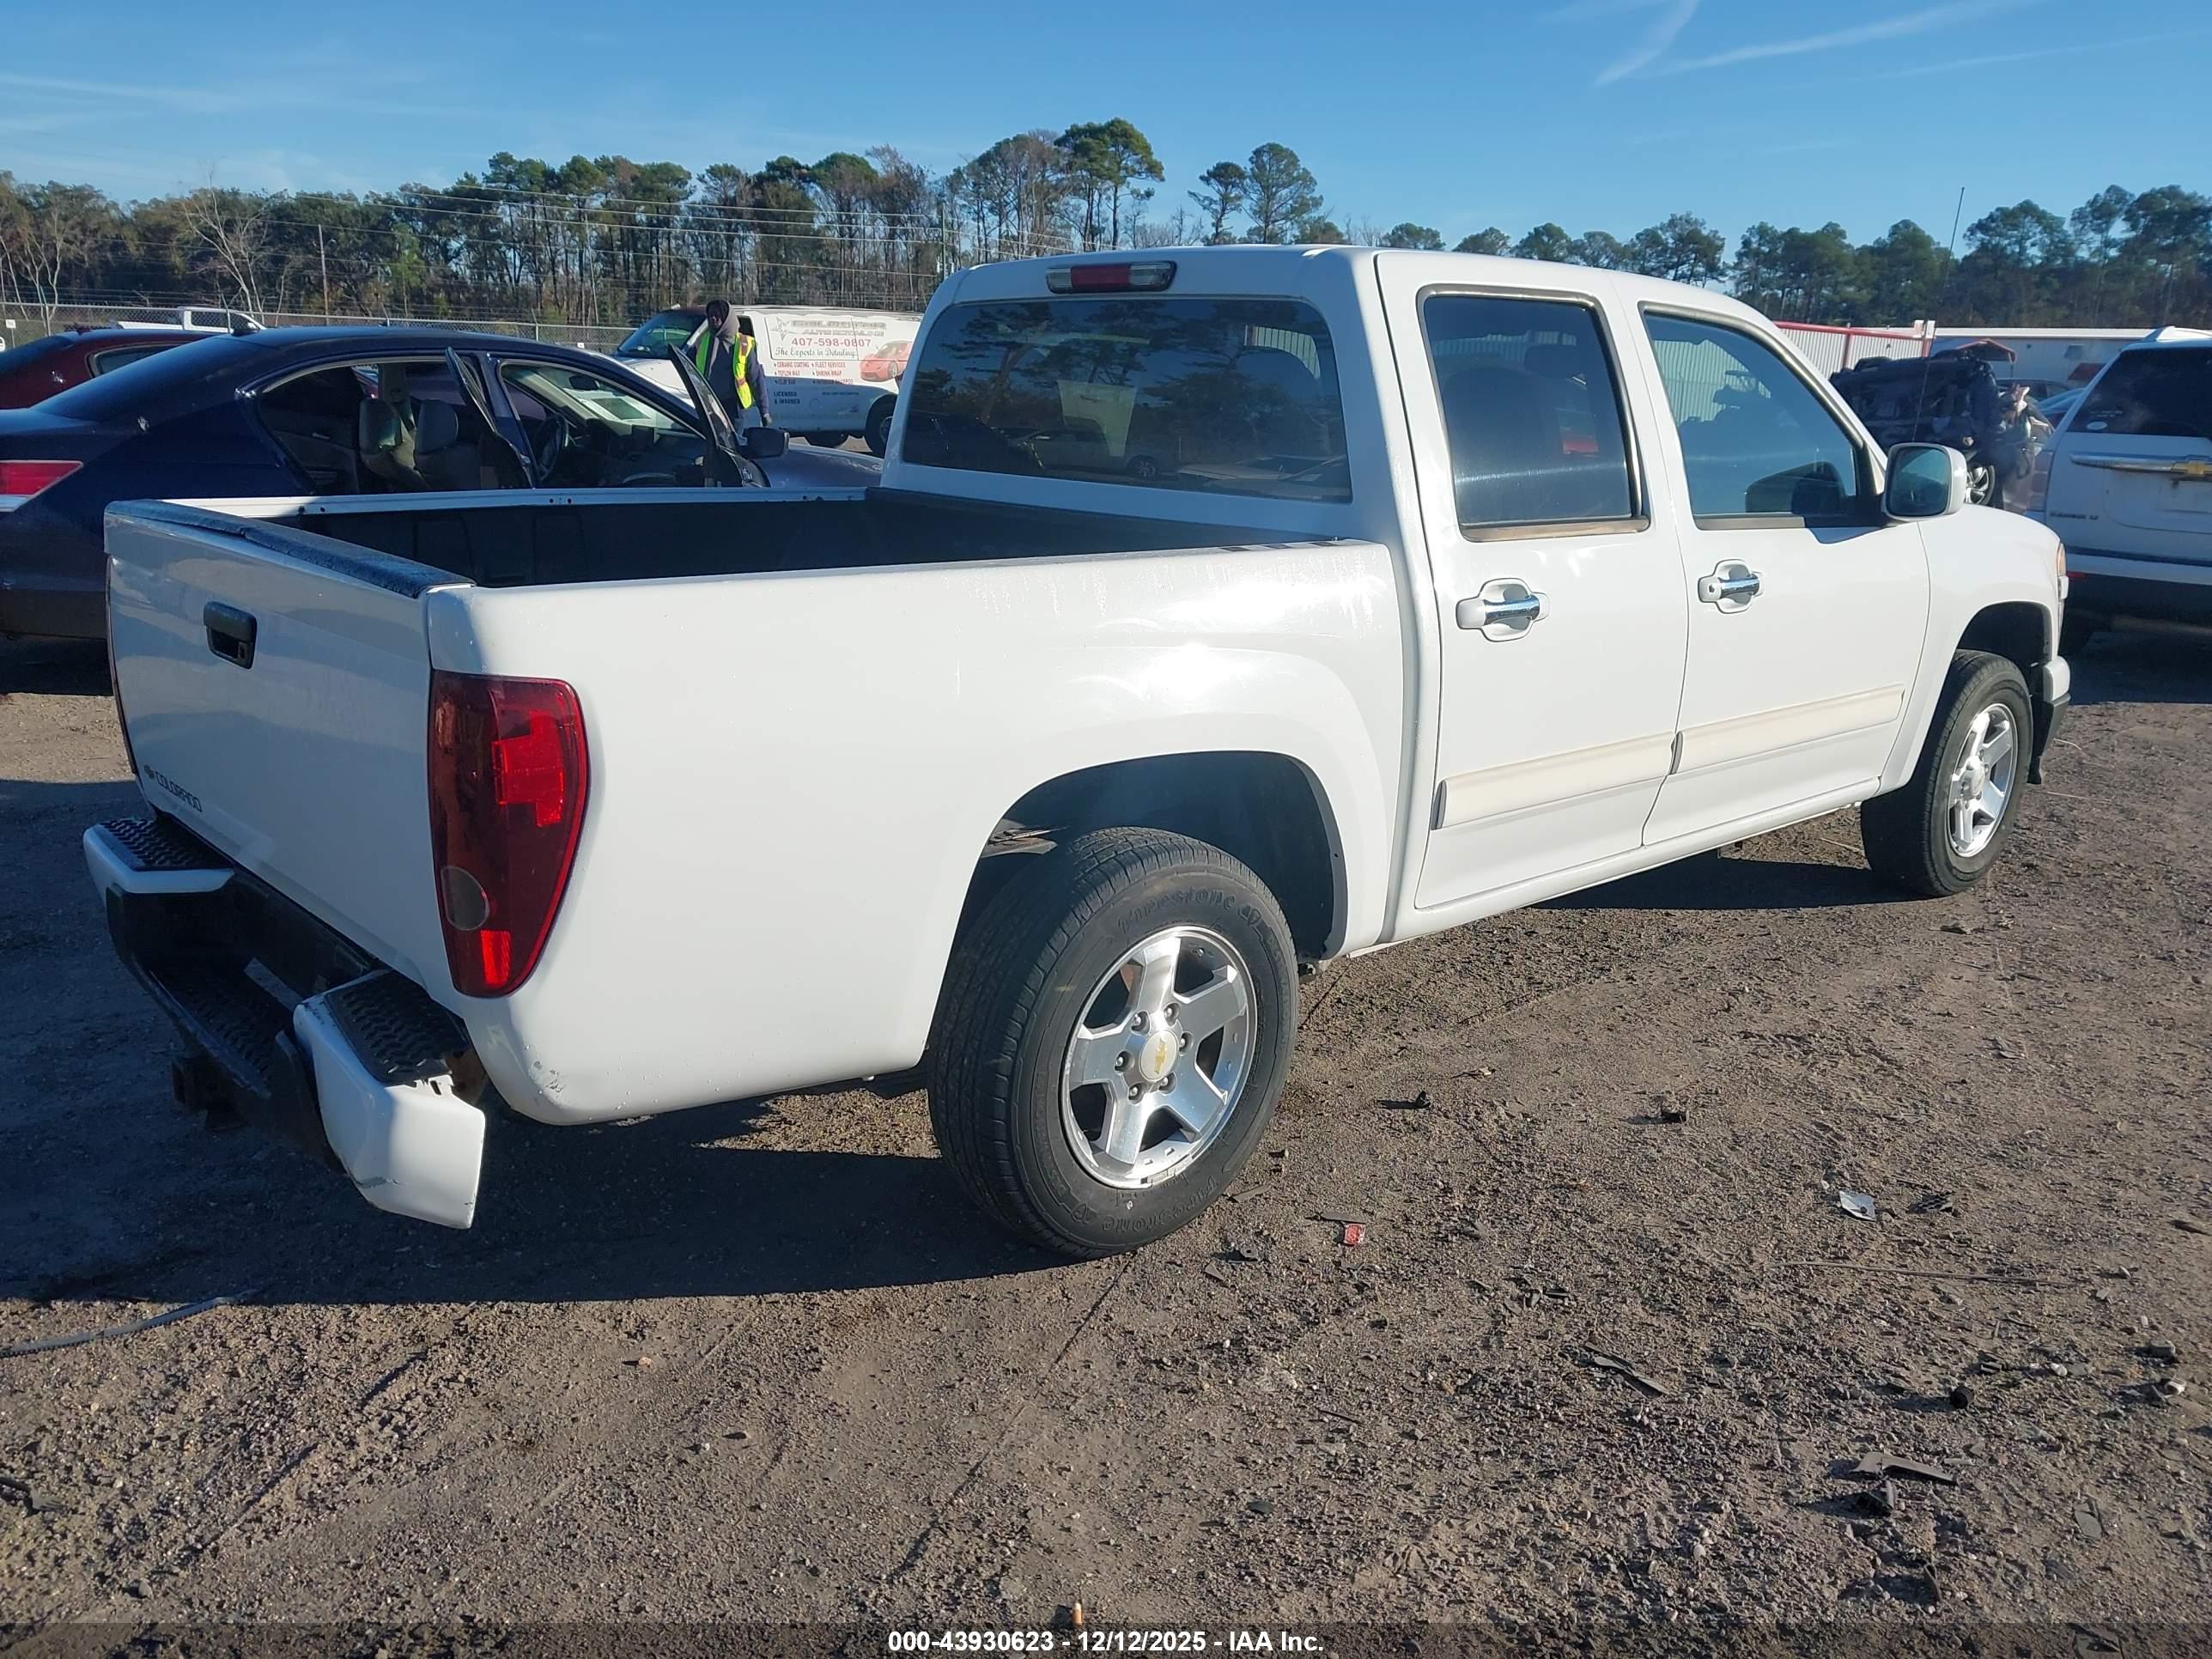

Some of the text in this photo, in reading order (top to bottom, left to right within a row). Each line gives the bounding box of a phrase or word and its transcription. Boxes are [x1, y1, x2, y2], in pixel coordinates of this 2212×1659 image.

[791, 337, 872, 347] 407-598-0807
[775, 347, 788, 356] The
[790, 348, 815, 358] Experts
[155, 771, 203, 812] COLORADO
